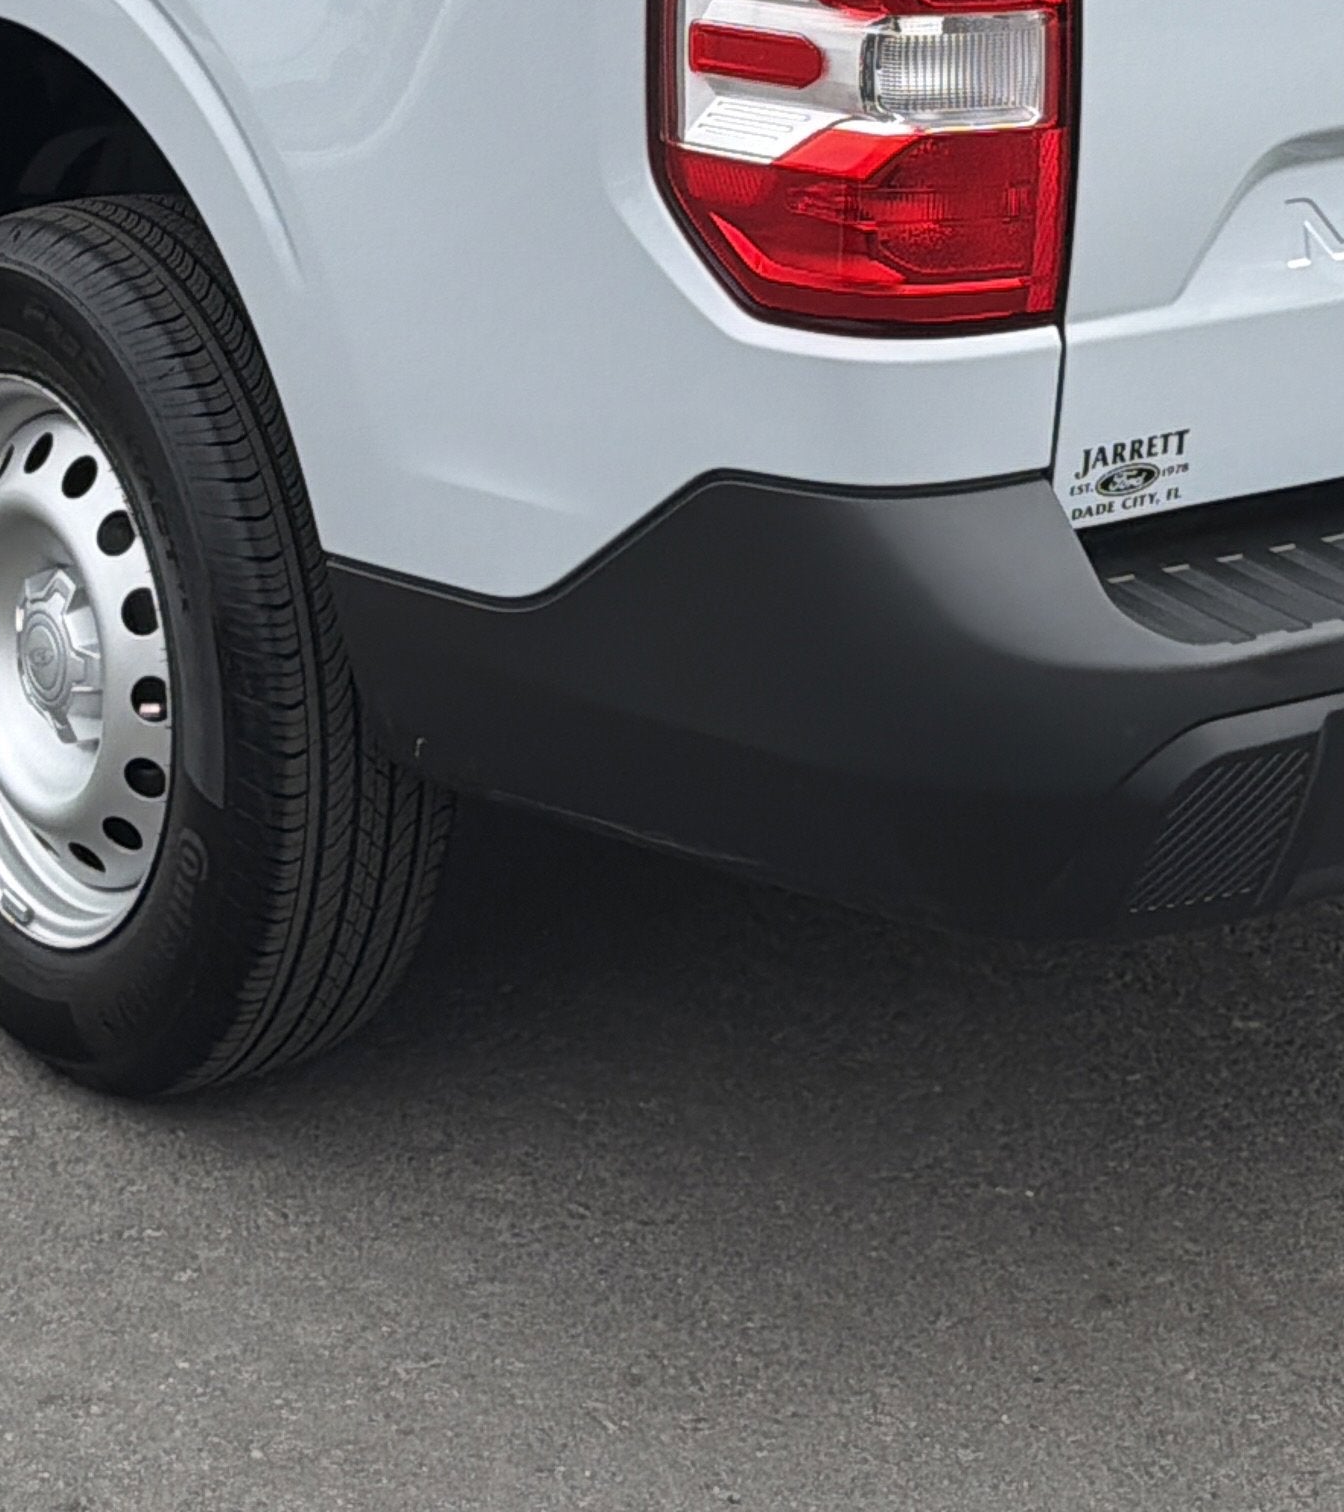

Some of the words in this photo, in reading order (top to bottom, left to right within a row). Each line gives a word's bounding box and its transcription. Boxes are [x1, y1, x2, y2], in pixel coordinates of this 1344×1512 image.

[1073, 428, 1191, 480] JARRETT
[1069, 482, 1094, 497] EST.
[1071, 500, 1116, 521] DADE
[1121, 491, 1162, 510] CITY,
[1166, 486, 1182, 501] FL
